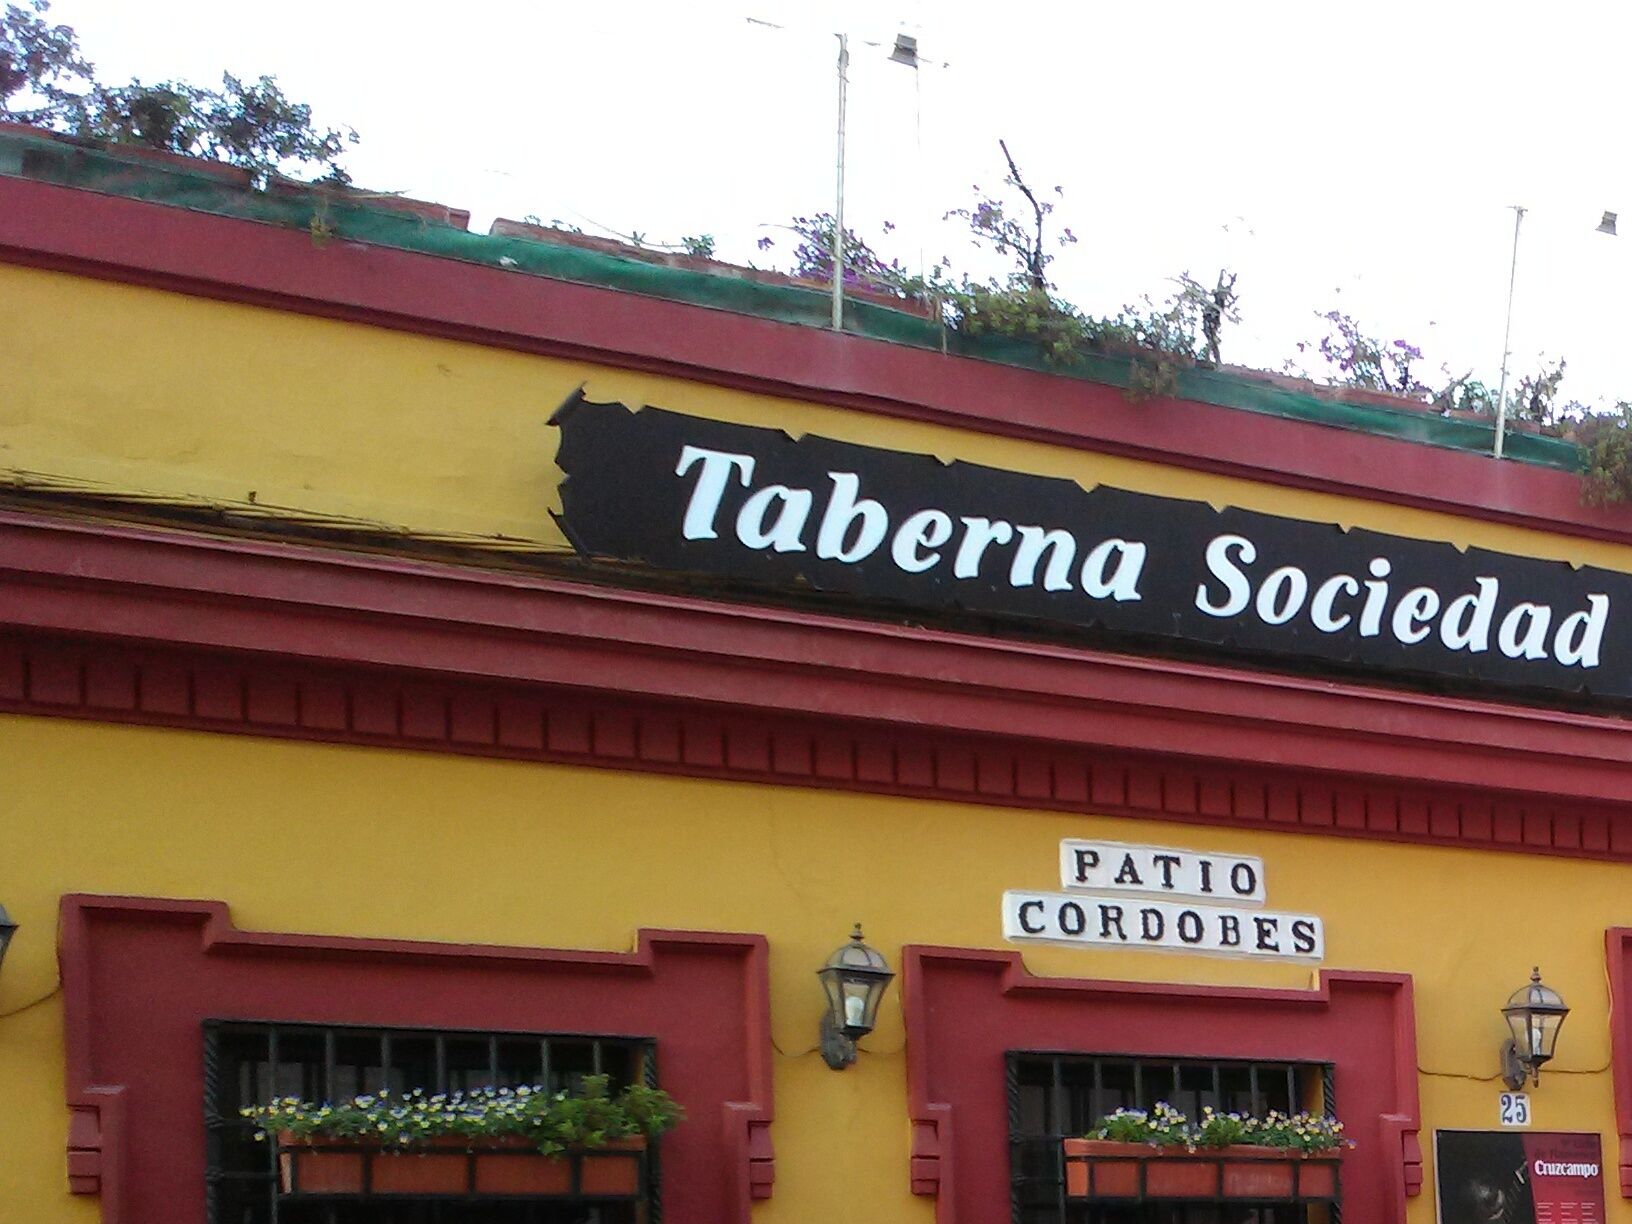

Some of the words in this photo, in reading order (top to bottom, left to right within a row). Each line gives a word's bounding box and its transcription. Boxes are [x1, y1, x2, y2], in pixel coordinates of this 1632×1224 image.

[675, 445, 1146, 602] Taberna
[1195, 535, 1610, 668] Sociedad
[1073, 848, 1257, 895] PATIO
[1018, 900, 1316, 953] CORDOBES
[1501, 1094, 1527, 1123] 25
[1534, 1159, 1599, 1178] Cruzcampo
